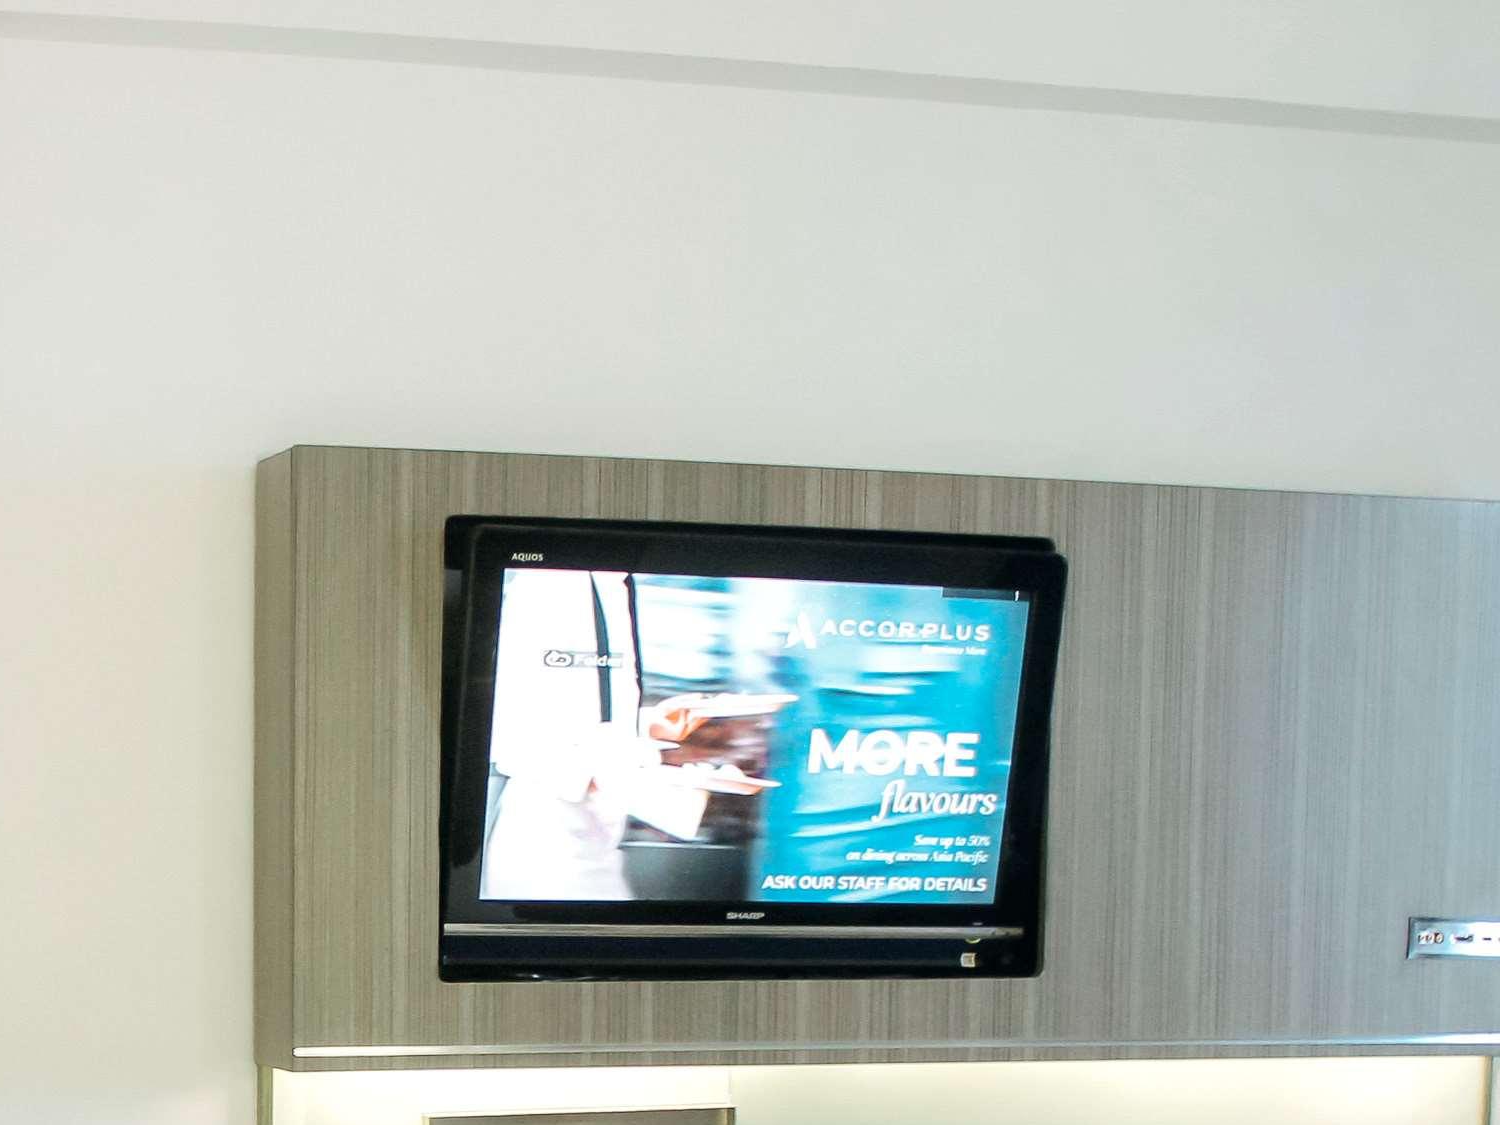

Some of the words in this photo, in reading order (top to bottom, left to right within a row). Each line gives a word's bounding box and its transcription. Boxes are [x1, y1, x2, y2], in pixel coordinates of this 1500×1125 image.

[511, 552, 544, 562] AQUOS
[808, 728, 980, 777] MORE
[871, 779, 997, 822] flavours
[955, 837, 967, 847] to
[955, 850, 988, 865] Pacific
[762, 875, 797, 890] ASK
[799, 875, 834, 890] OUR
[838, 876, 887, 891] STAFF
[887, 877, 920, 891] FOR
[923, 877, 988, 892] DETAILS
[726, 911, 766, 920] SHARP
